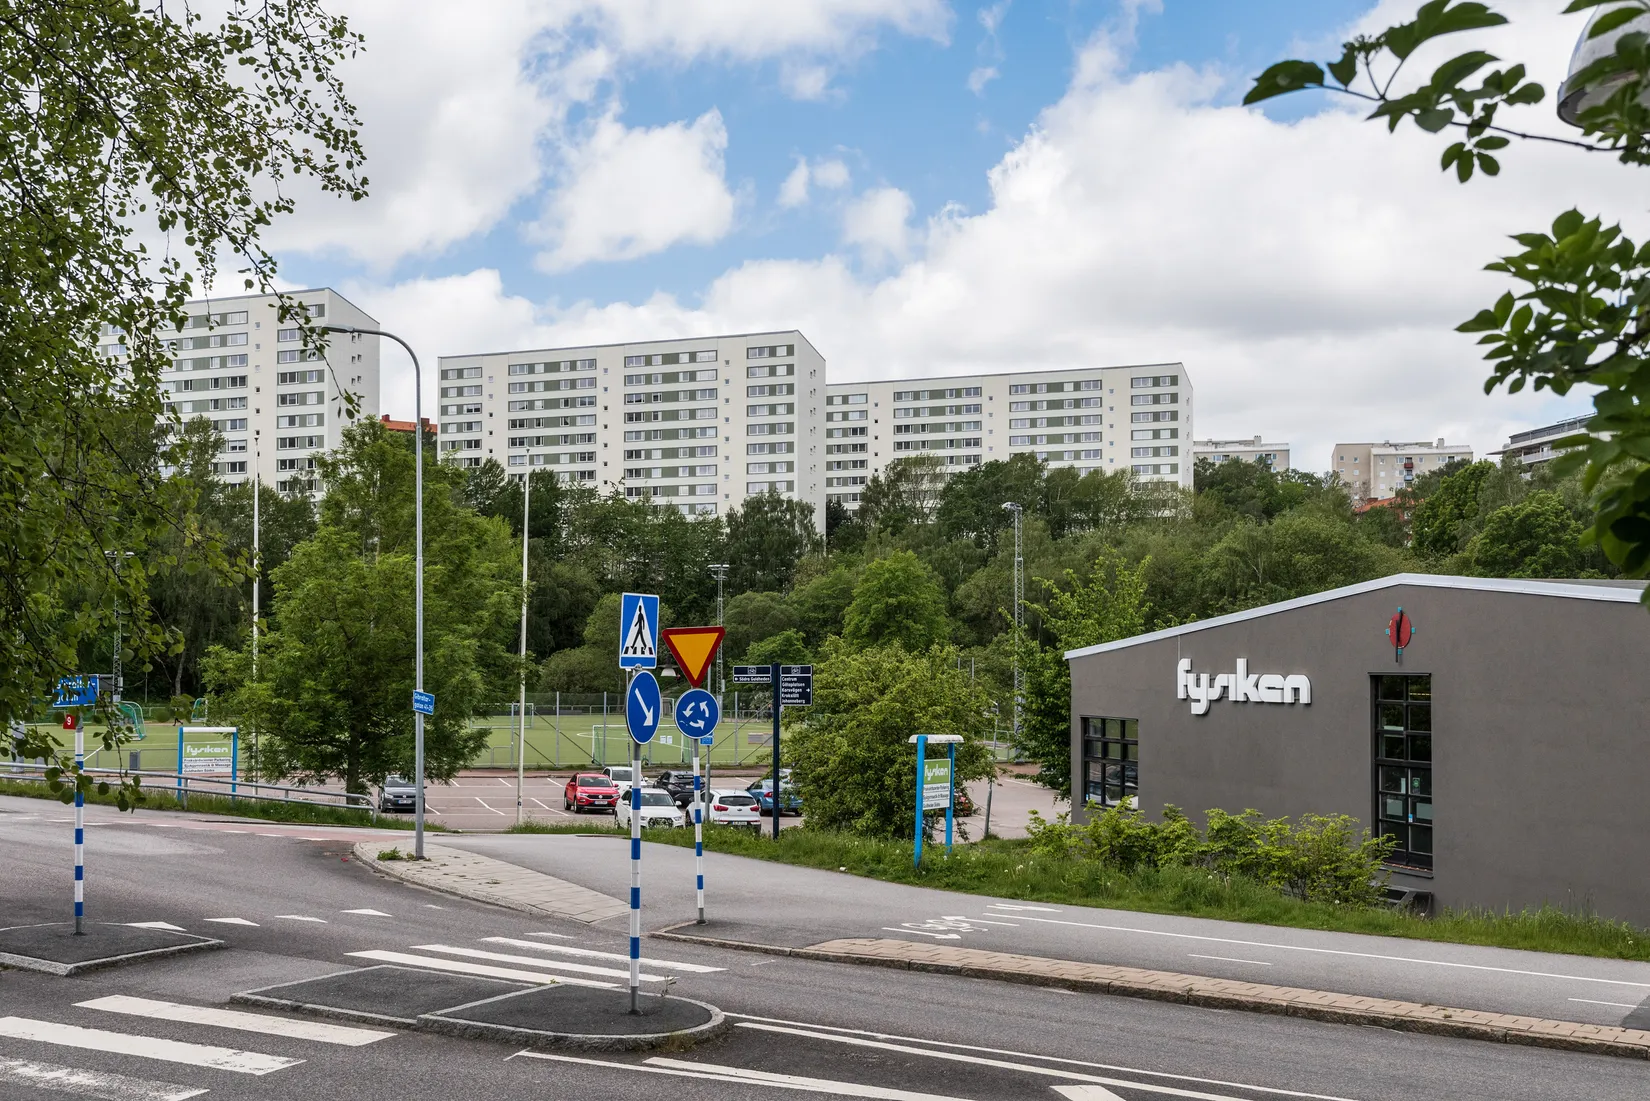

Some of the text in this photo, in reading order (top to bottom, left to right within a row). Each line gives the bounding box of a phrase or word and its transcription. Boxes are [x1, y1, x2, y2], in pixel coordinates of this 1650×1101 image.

[1177, 657, 1312, 715] fysiken
[67, 717, 71, 725] 9
[186, 745, 228, 756] fysiken
